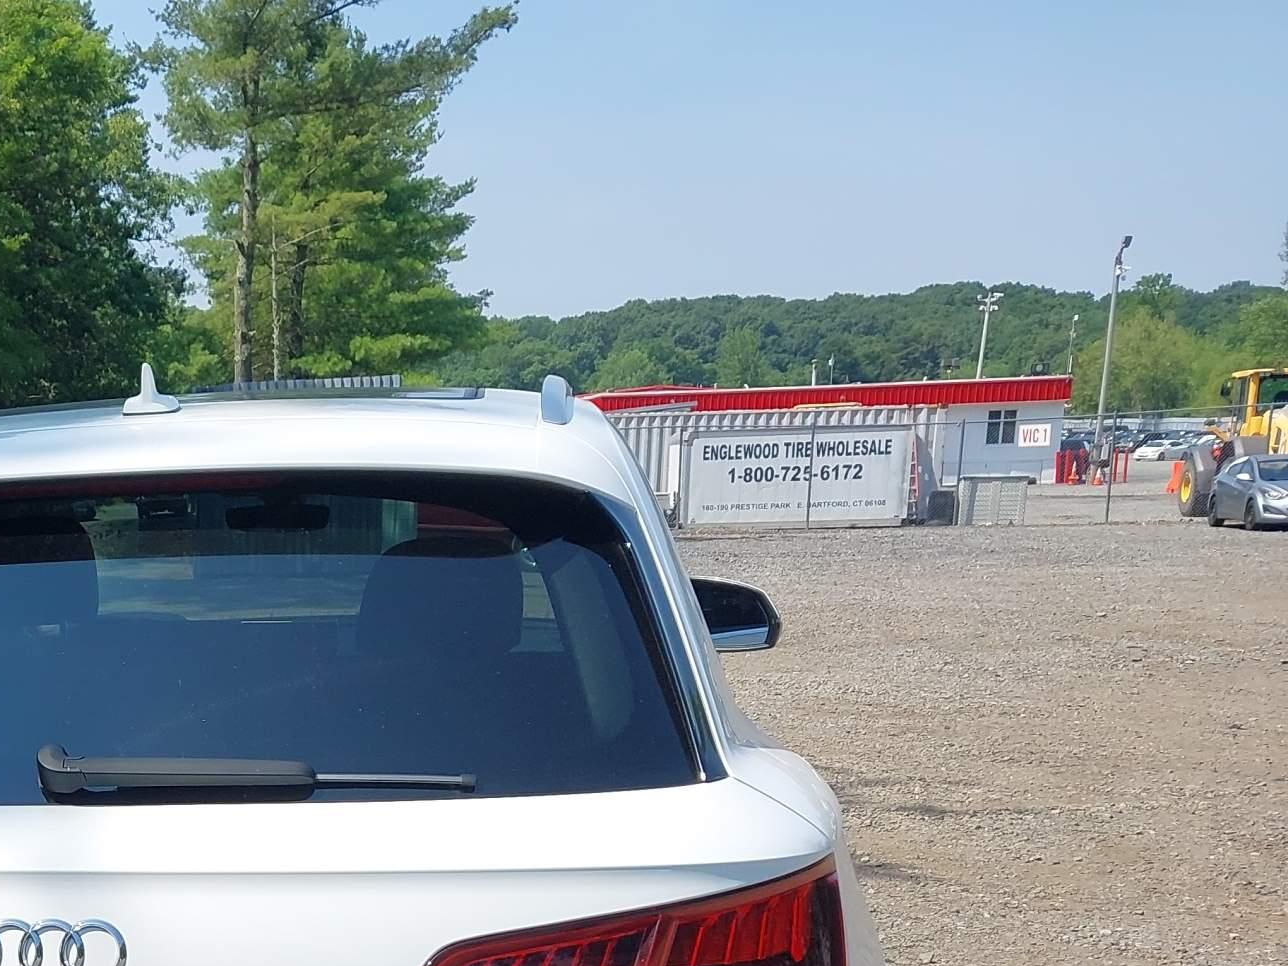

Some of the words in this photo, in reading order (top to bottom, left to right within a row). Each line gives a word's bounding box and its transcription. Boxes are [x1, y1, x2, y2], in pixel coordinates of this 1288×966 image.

[1022, 428, 1039, 443] VIC
[1043, 428, 1048, 443] 1
[703, 443, 779, 461] ENGLEWOOD
[784, 441, 812, 458] TIRE
[816, 439, 893, 457] WHOLESALE
[728, 463, 863, 483] 1-800-725-6172
[730, 503, 768, 511] PRESTIGE
[770, 502, 791, 510] PARK
[852, 499, 863, 507] CT
